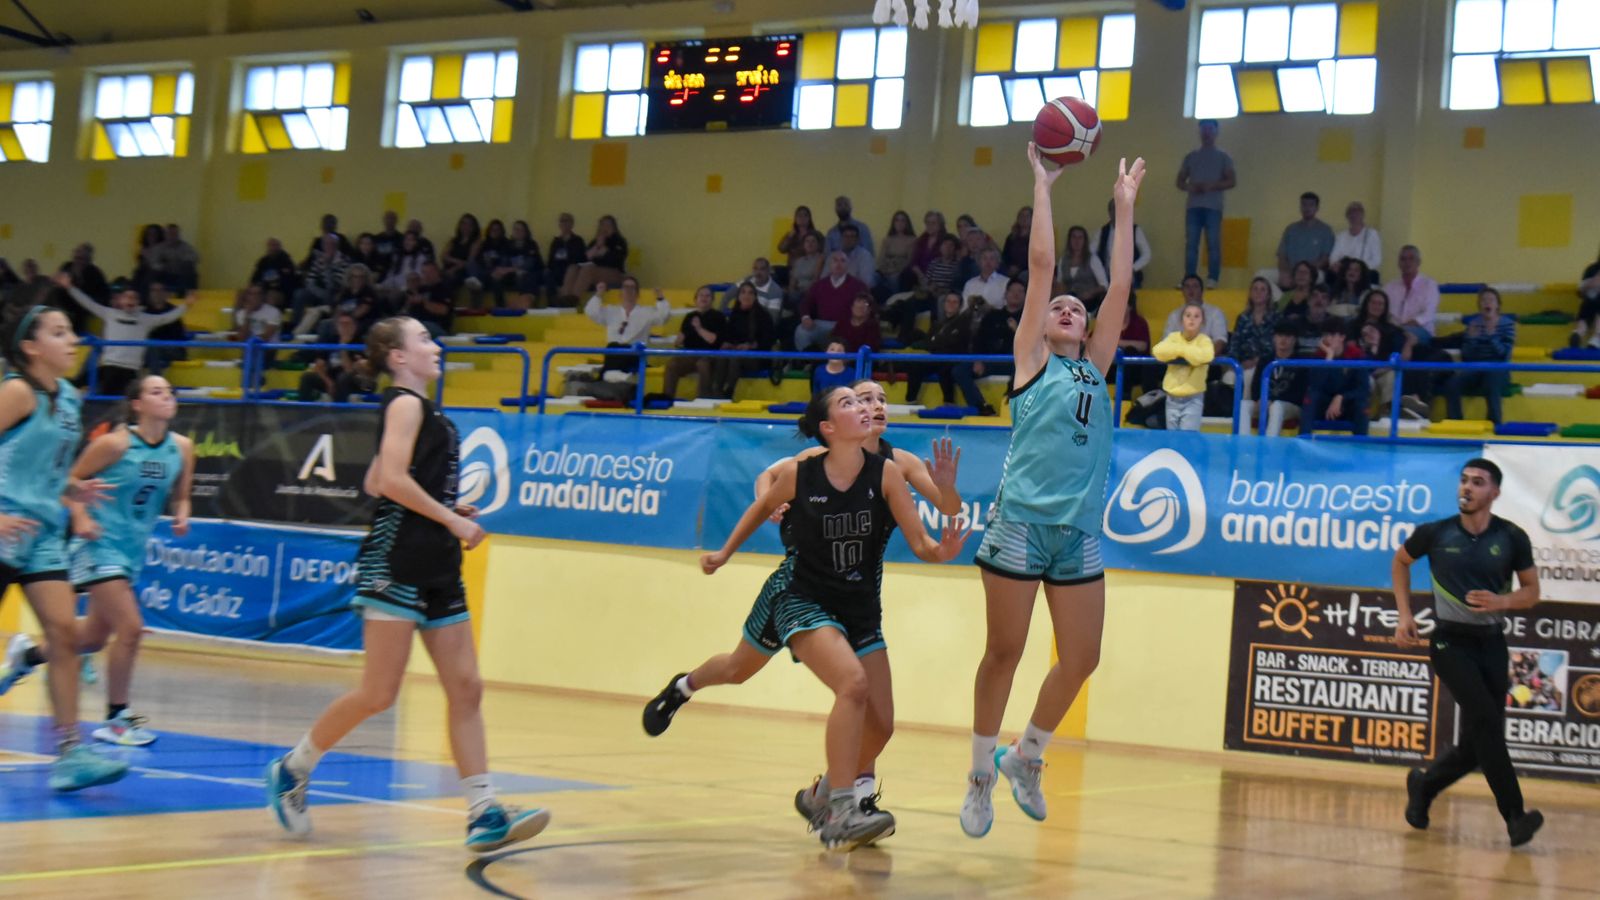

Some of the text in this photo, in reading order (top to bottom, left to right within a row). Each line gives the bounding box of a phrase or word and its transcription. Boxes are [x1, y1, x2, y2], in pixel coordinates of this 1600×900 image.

[523, 443, 673, 483] baloncesto
[1226, 470, 1432, 514] baloncesto
[145, 538, 269, 578] Diputación
[142, 581, 244, 619] de Cádiz
[1256, 651, 1430, 680] BAR SNACK TERRAZA
[1254, 676, 1428, 716] RESTAURANTE
[1252, 709, 1426, 750] BUFFET LIBRE
